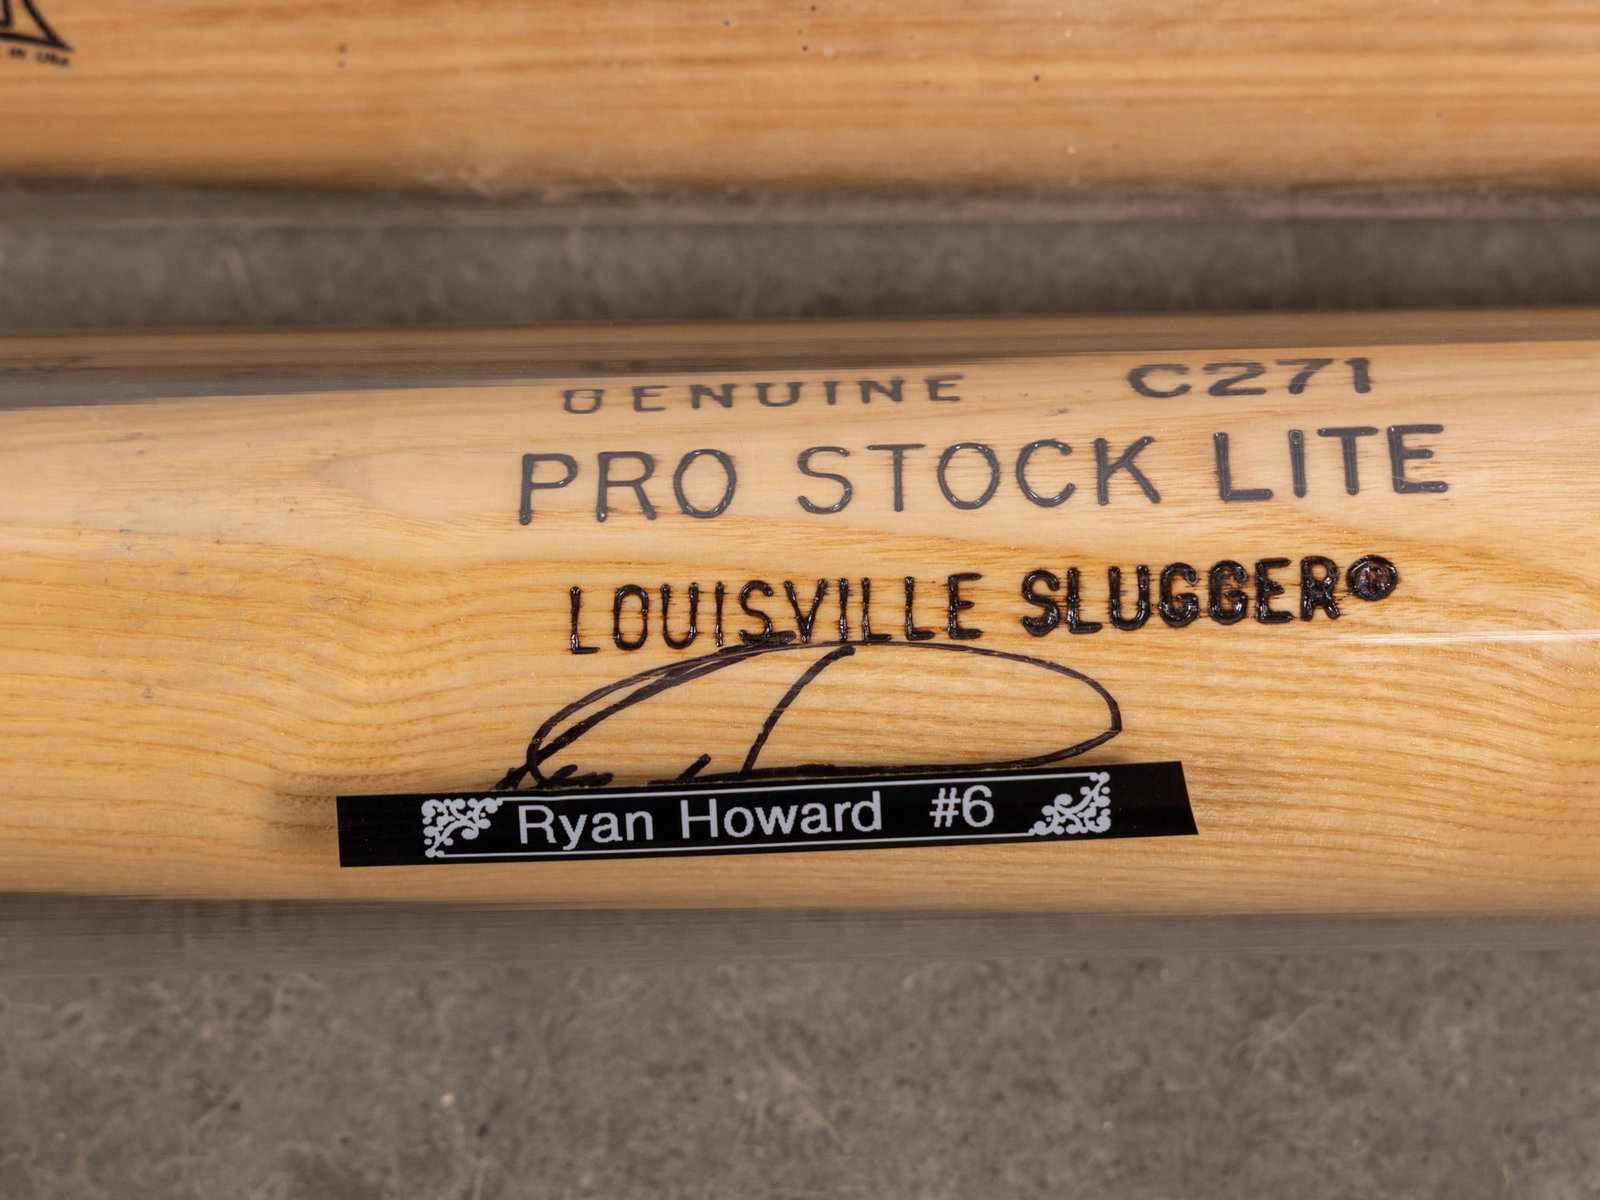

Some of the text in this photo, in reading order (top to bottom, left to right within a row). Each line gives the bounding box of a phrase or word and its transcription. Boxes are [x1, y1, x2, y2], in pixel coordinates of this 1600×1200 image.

[563, 356, 1373, 415] GENUINE C271
[519, 423, 1450, 526] PRO STOCK LITE
[569, 572, 984, 655] LOUISVILLE
[518, 784, 995, 852] Ryan Howard #6
